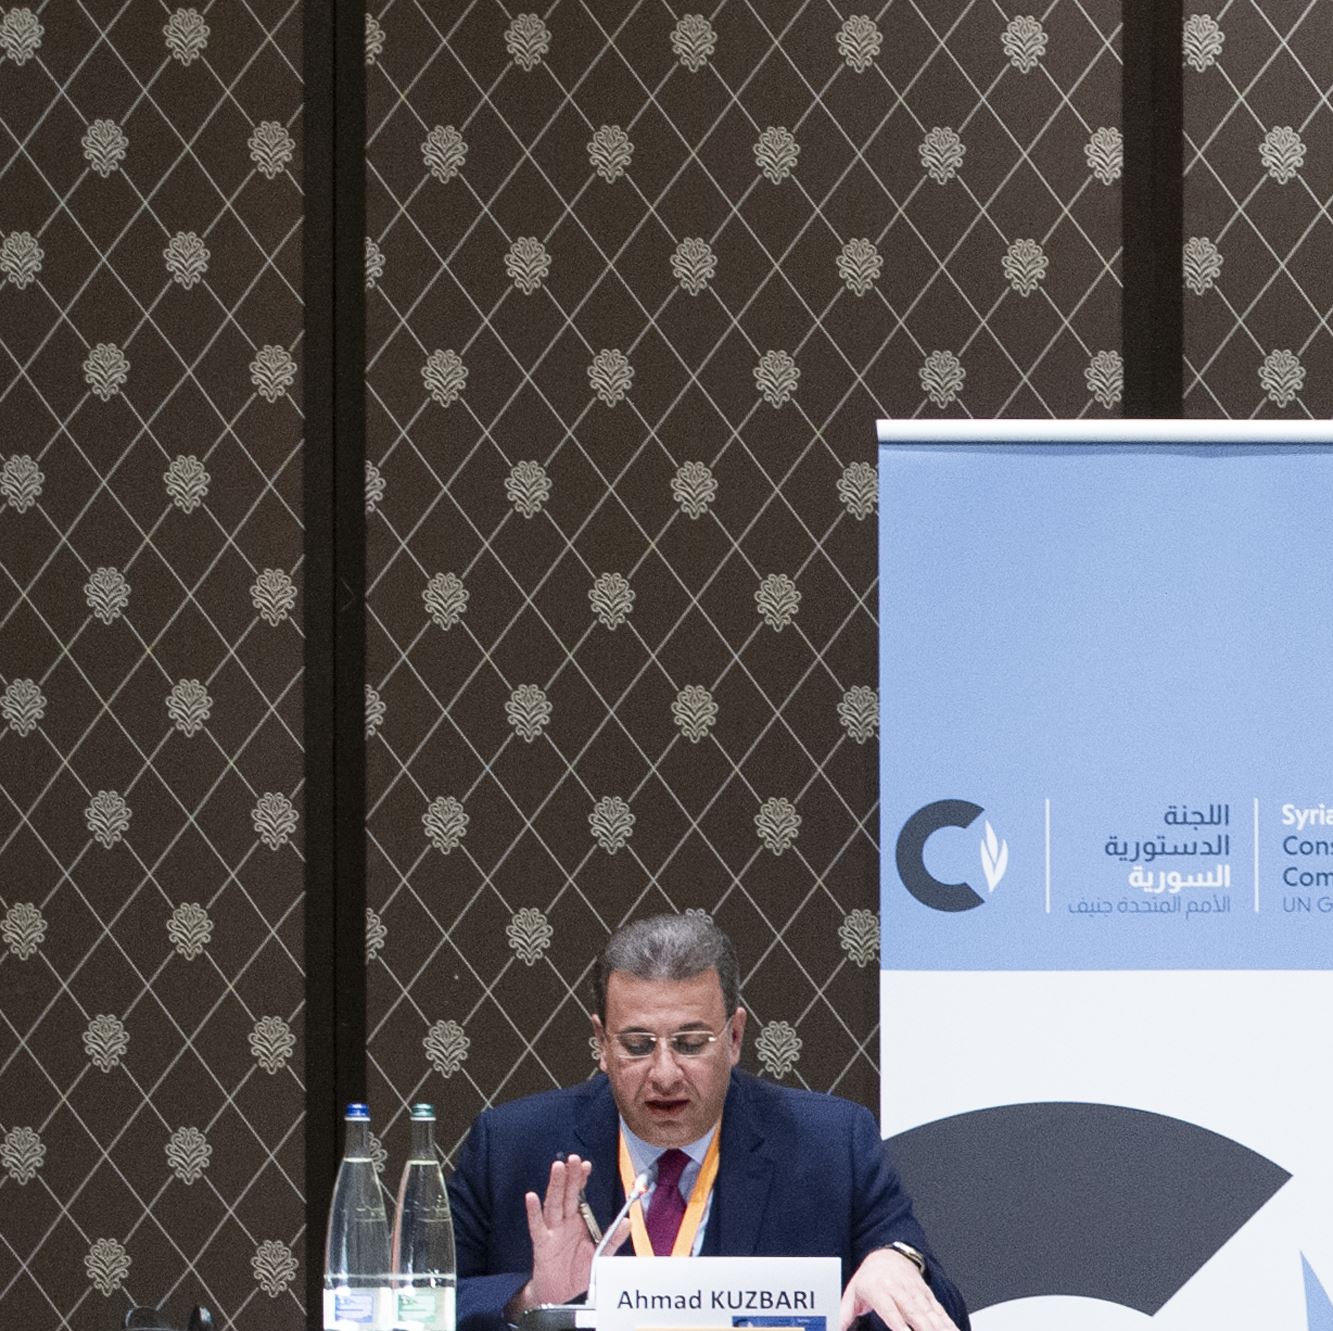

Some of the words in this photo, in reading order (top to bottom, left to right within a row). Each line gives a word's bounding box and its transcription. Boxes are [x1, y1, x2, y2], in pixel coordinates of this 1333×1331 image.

[1164, 804, 1229, 828] اللجنة
[1105, 835, 1229, 862] الدستورية
[1129, 865, 1230, 892] السورية
[1283, 897, 1310, 912] UN
[618, 1290, 701, 1309] Ahmad
[712, 1291, 814, 1309] KUZBARI
